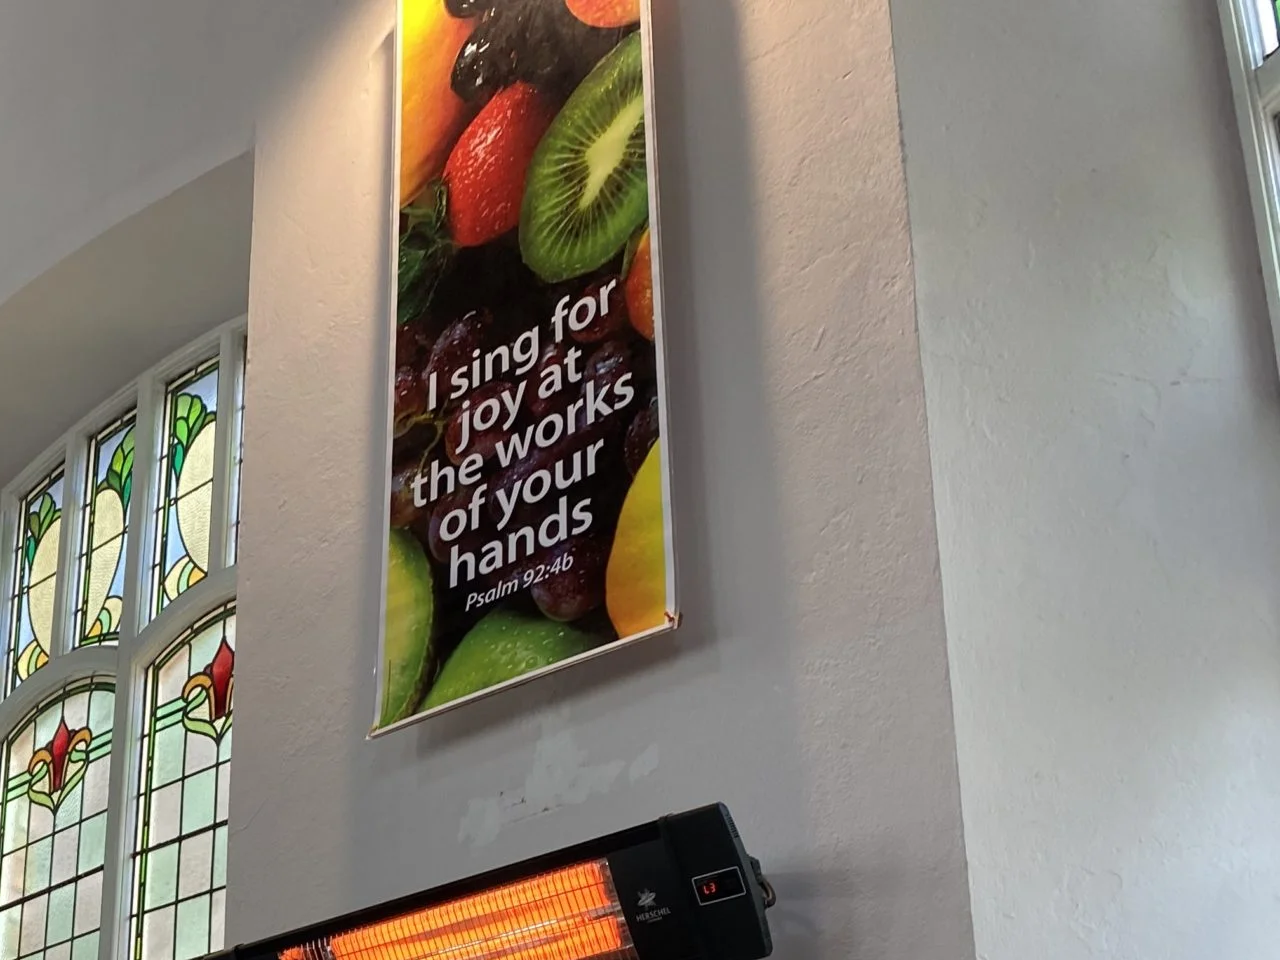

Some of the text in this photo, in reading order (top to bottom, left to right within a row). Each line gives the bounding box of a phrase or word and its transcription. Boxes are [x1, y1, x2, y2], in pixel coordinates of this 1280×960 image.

[427, 279, 616, 411] I sing for
[411, 372, 635, 508] the works
[455, 346, 583, 455] joy at
[439, 439, 604, 542] of your
[450, 497, 593, 589] hands
[464, 554, 574, 612] Psalm 92:4b
[635, 906, 671, 923] HERSCHEL
